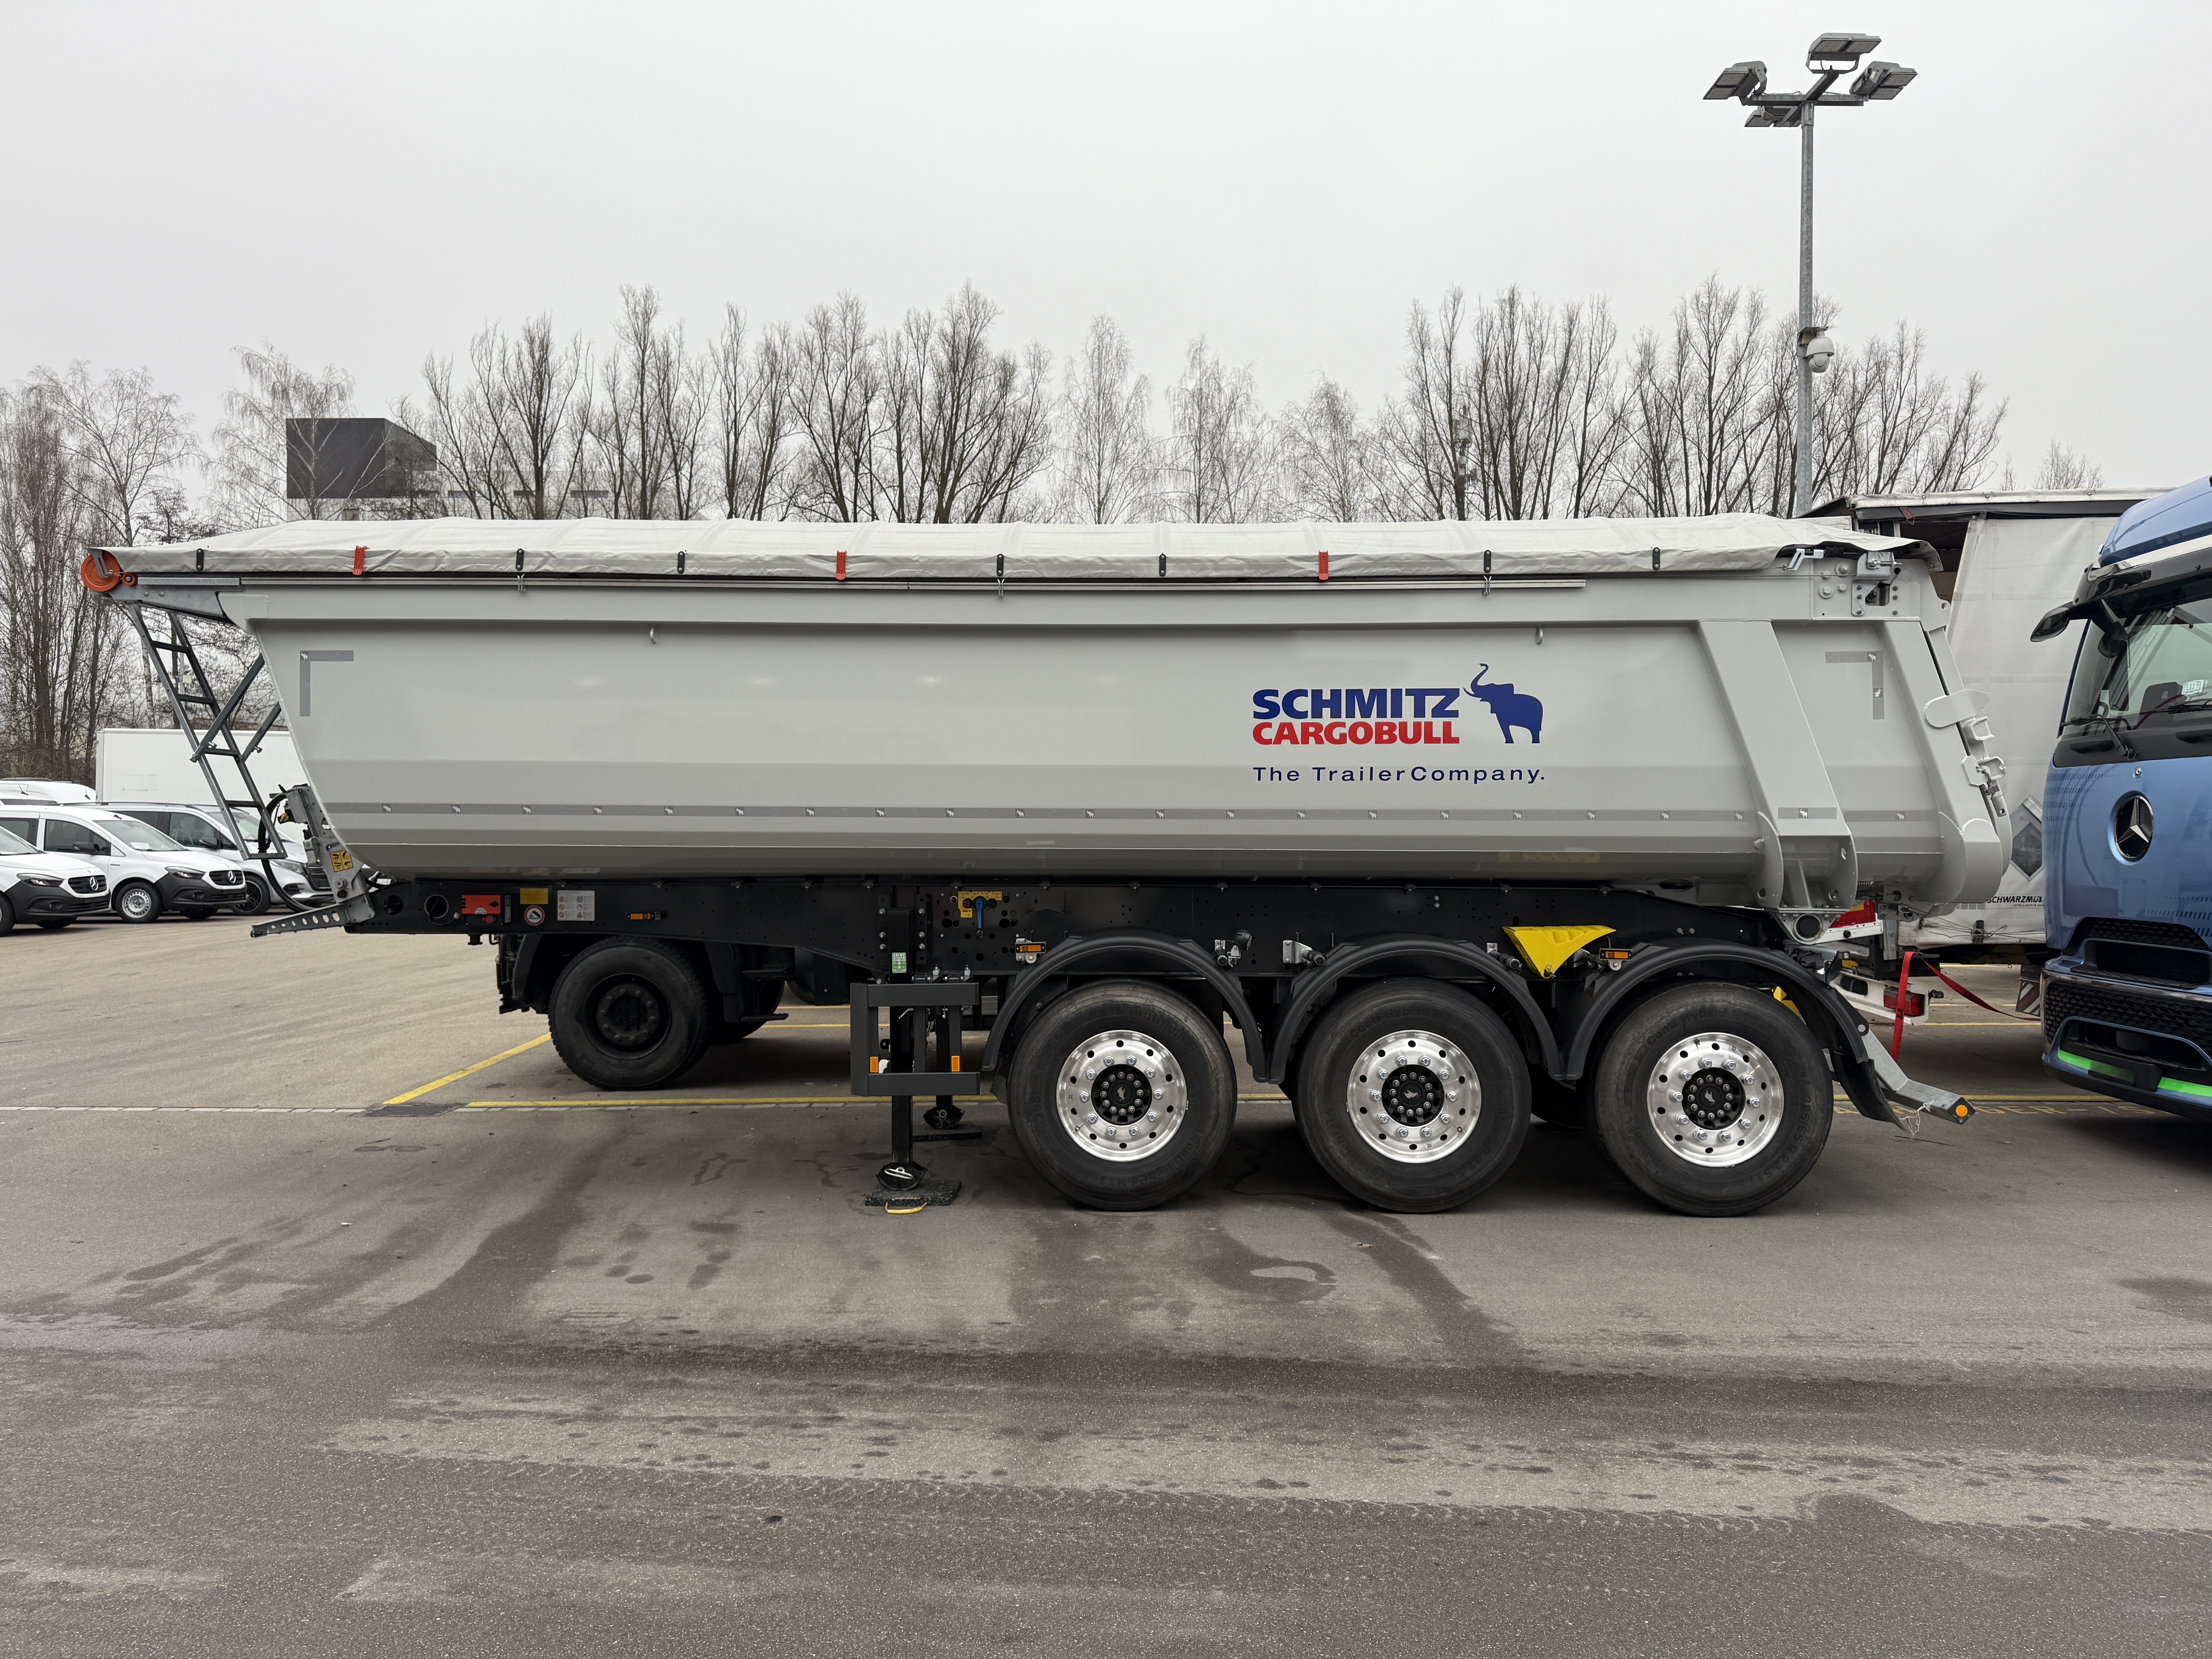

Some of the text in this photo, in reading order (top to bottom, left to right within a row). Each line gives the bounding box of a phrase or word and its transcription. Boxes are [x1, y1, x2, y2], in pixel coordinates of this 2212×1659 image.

[1253, 688, 1460, 720] SCHMITZ
[1253, 721, 1460, 745] CARGOBULL
[1253, 767, 1300, 781] The
[1350, 1013, 1381, 1038] Conti
[1646, 1019, 1678, 1045] Conti
[1763, 1096, 1812, 1180] 385/65 R 22.5
